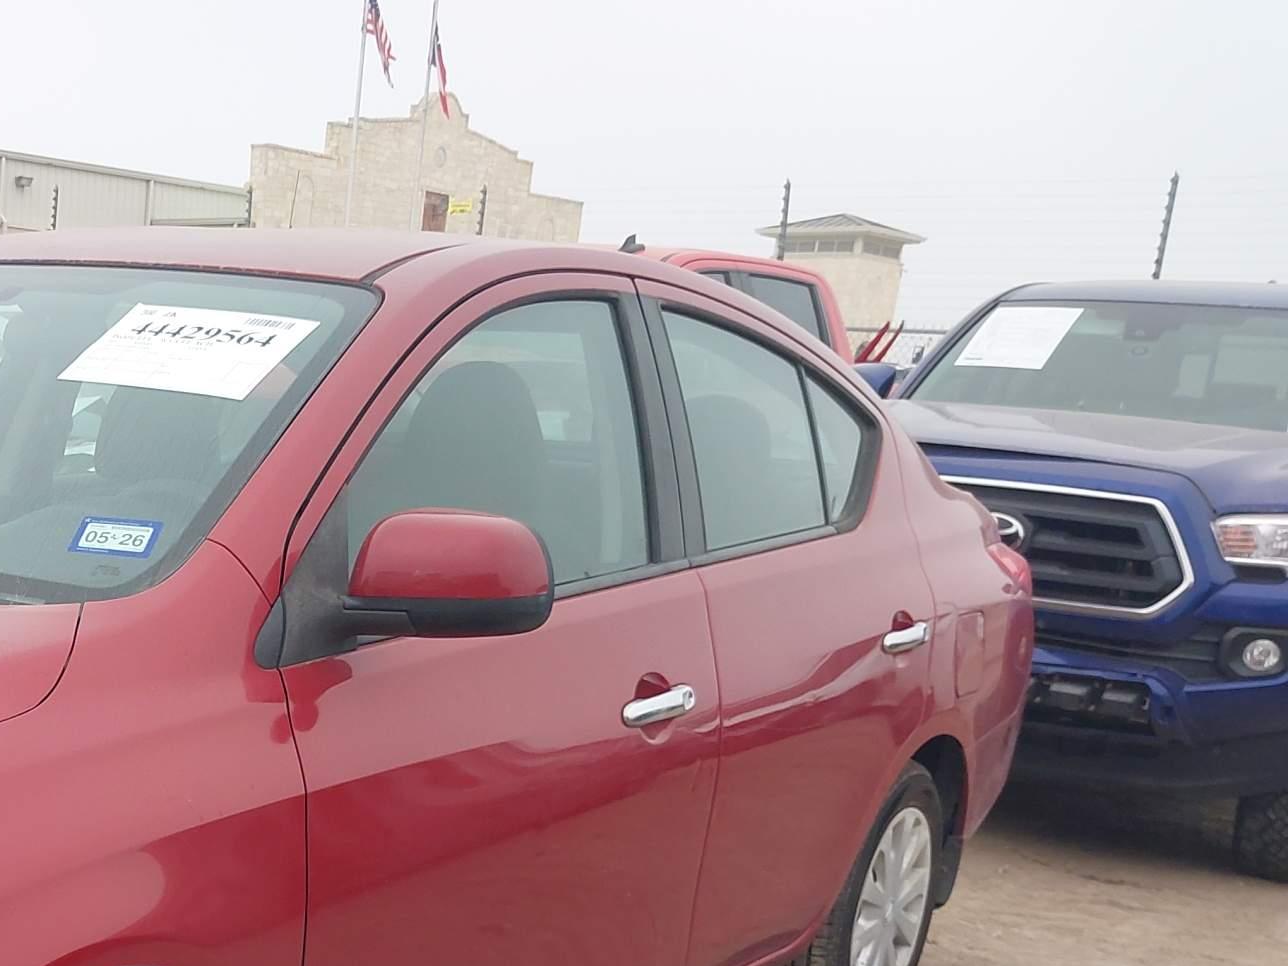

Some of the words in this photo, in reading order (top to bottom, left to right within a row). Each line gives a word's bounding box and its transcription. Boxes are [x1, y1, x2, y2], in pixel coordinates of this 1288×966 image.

[131, 321, 279, 348] 44429564
[85, 531, 110, 544] 05
[118, 533, 145, 547] 26
